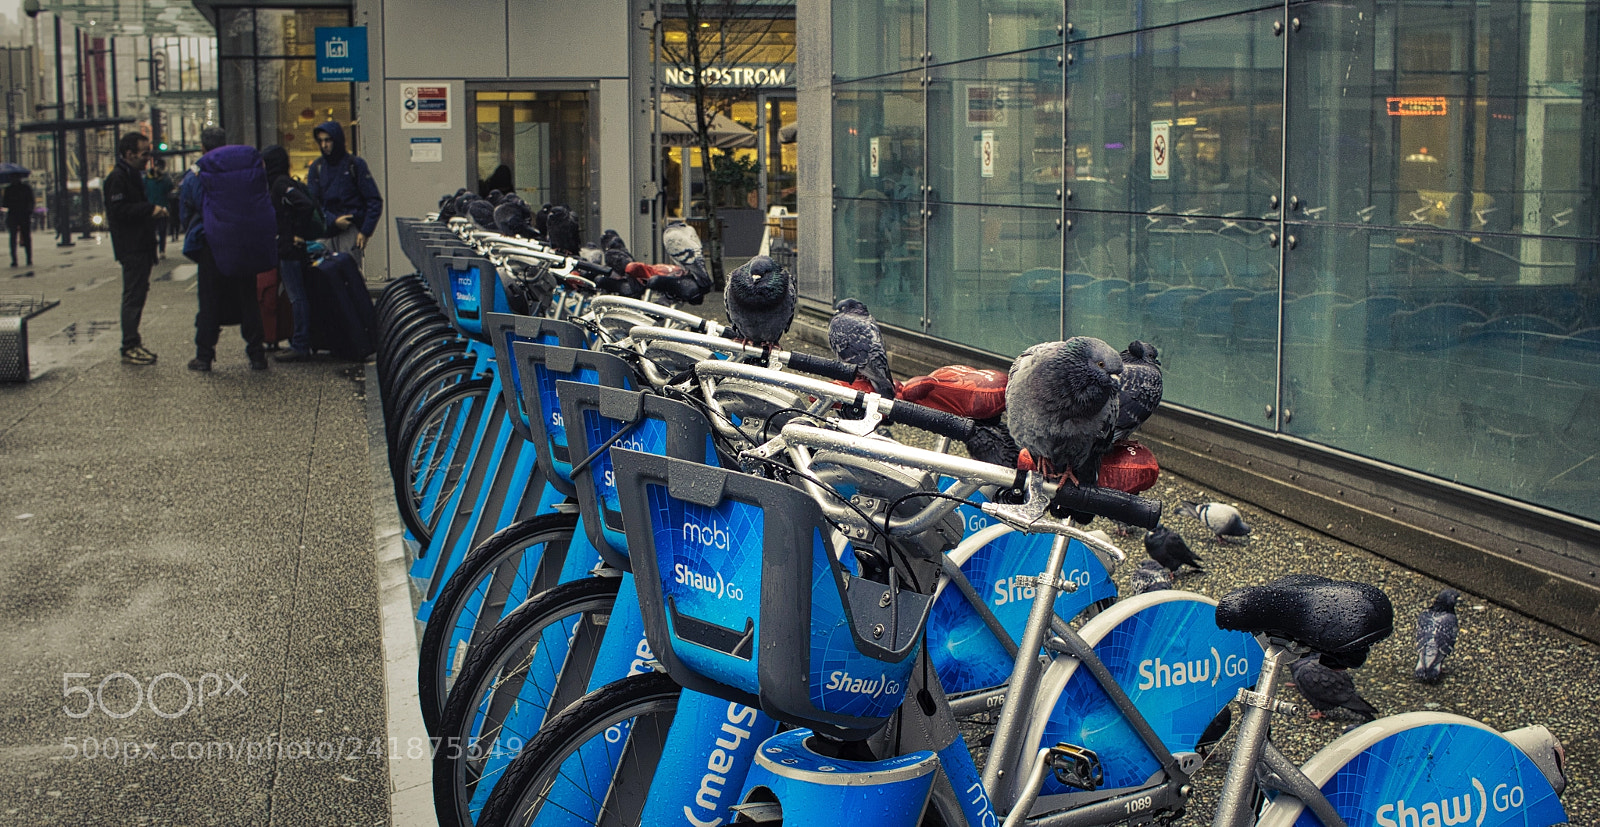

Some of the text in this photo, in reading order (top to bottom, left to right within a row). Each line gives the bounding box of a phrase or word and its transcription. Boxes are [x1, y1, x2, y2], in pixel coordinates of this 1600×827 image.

[321, 66, 354, 74] Elevator
[683, 519, 730, 552] mobi
[1069, 568, 1091, 589] Go
[726, 582, 744, 601] Go
[1224, 654, 1249, 678] Go
[884, 680, 900, 695] Go
[1124, 795, 1152, 815] 1089
[1492, 783, 1525, 813] Go
